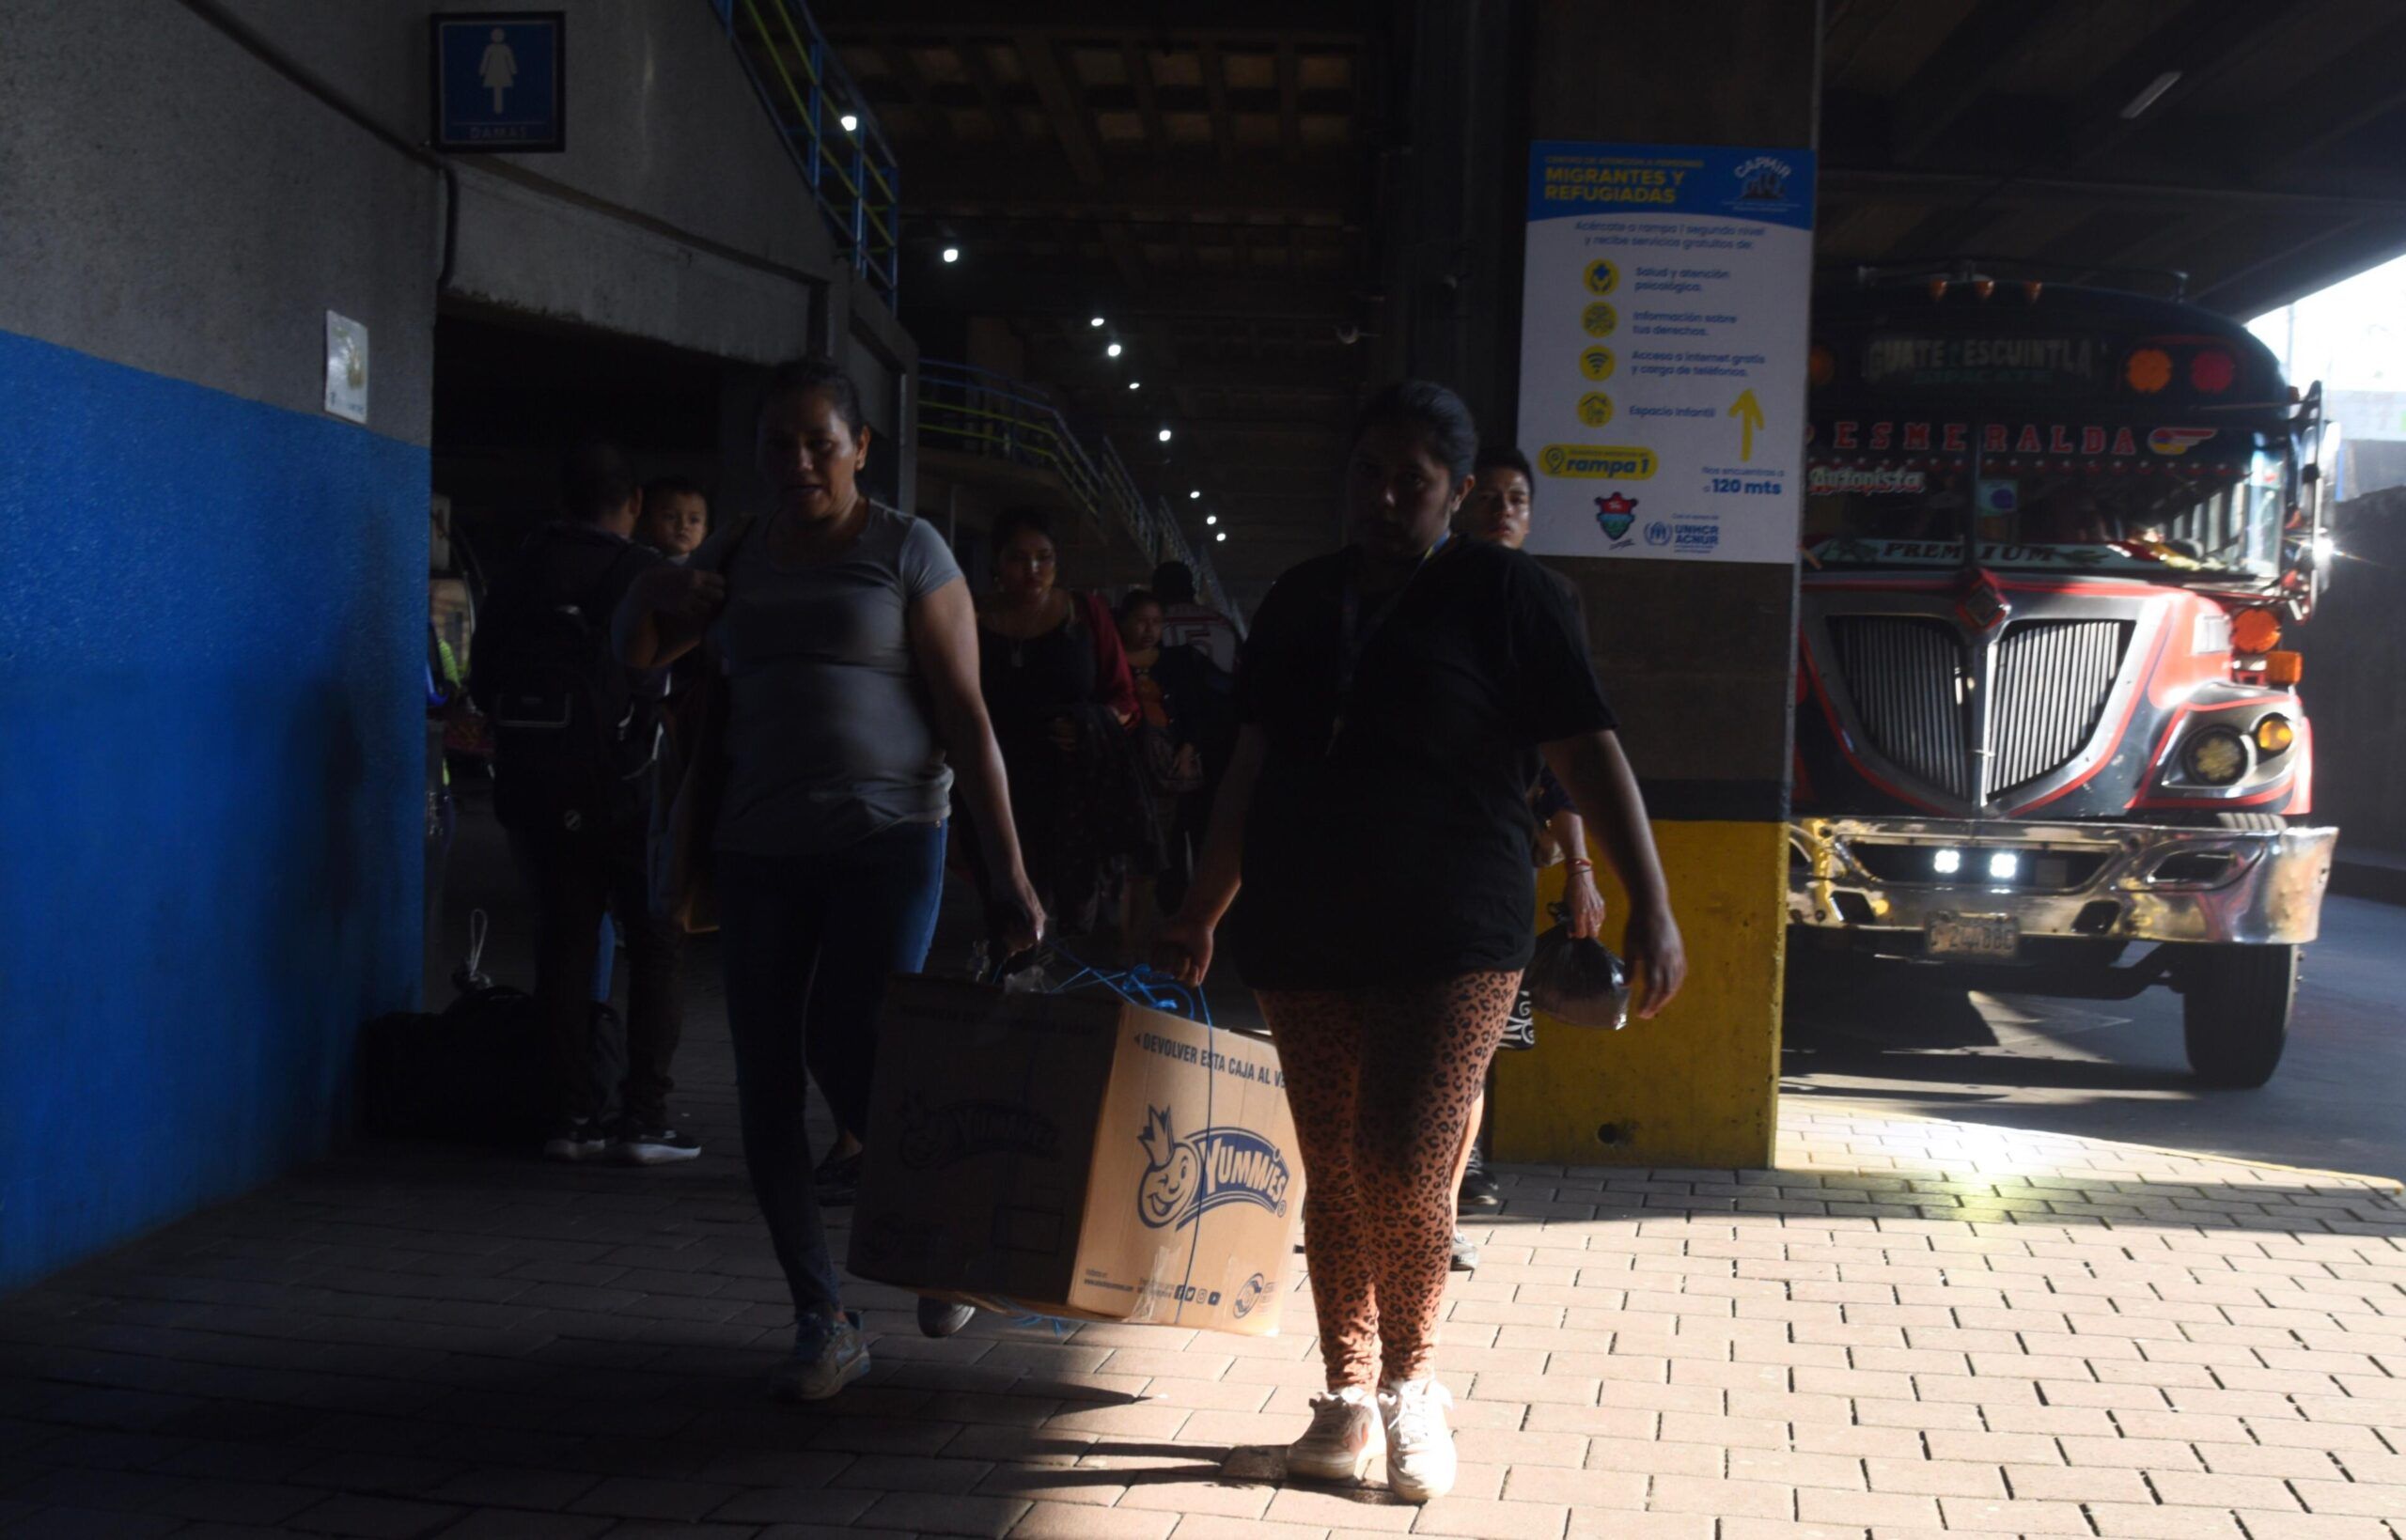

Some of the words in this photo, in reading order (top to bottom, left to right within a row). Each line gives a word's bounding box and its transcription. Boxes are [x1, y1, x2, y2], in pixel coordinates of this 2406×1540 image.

[469, 126, 528, 139] DAMAS
[1544, 166, 1666, 185] MIGRANTES
[1671, 171, 1685, 185] Y
[1544, 184, 1677, 204] REFUGIADAS
[1635, 266, 1669, 278] Salud
[1705, 314, 1737, 324] sobre
[1632, 350, 1673, 362] Acceso
[1963, 337, 2093, 378] ESCUINTLA
[1676, 366, 1691, 375] de
[1630, 405, 1673, 418] Espacio
[1675, 407, 1716, 417] infantil
[1834, 423, 2136, 455] ESMERALDA
[1567, 459, 1636, 477] rampa
[1640, 458, 1649, 474] 1
[1712, 478, 1742, 493] 120
[1744, 481, 1782, 495] mts
[1143, 1033, 1196, 1063] DEVOLVER
[1200, 1050, 1225, 1071] ESTA
[1228, 1058, 1254, 1080] CAJA
[1258, 1066, 1271, 1084] AL
